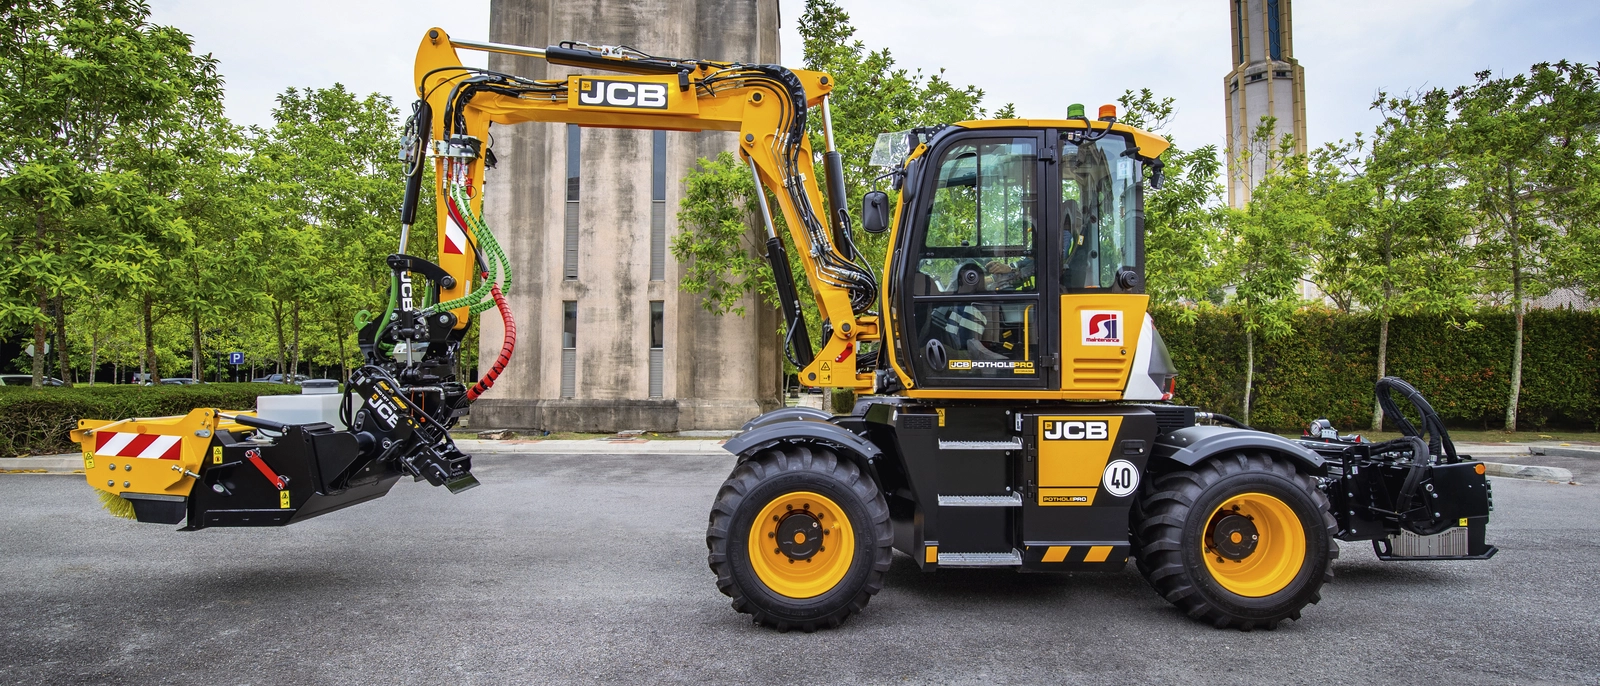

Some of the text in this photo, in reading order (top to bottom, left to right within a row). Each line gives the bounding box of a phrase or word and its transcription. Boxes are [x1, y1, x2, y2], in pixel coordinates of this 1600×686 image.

[581, 82, 666, 106] JCB
[400, 270, 413, 312] JCB
[233, 353, 241, 363] P
[1045, 422, 1107, 439] JCB
[1111, 467, 1131, 489] 40
